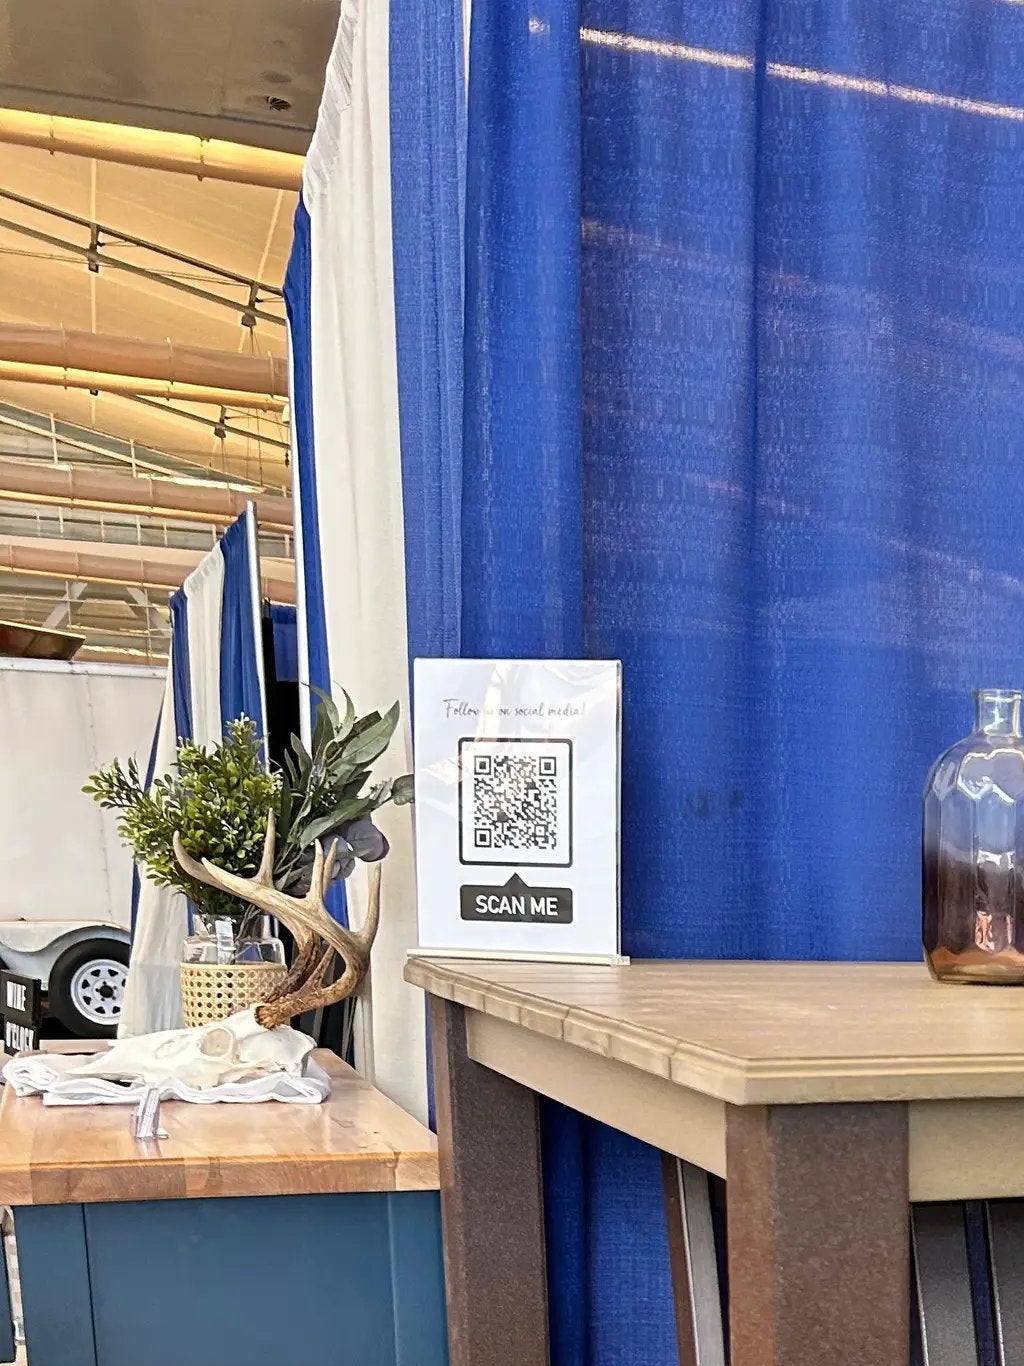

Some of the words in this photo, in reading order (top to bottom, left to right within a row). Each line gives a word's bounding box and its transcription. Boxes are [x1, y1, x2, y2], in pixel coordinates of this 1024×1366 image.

[443, 698, 479, 719] Follow
[498, 708, 511, 716] on
[514, 702, 545, 717] social
[548, 703, 586, 717] media!
[475, 895, 525, 915] SCAN
[530, 897, 559, 916] ME
